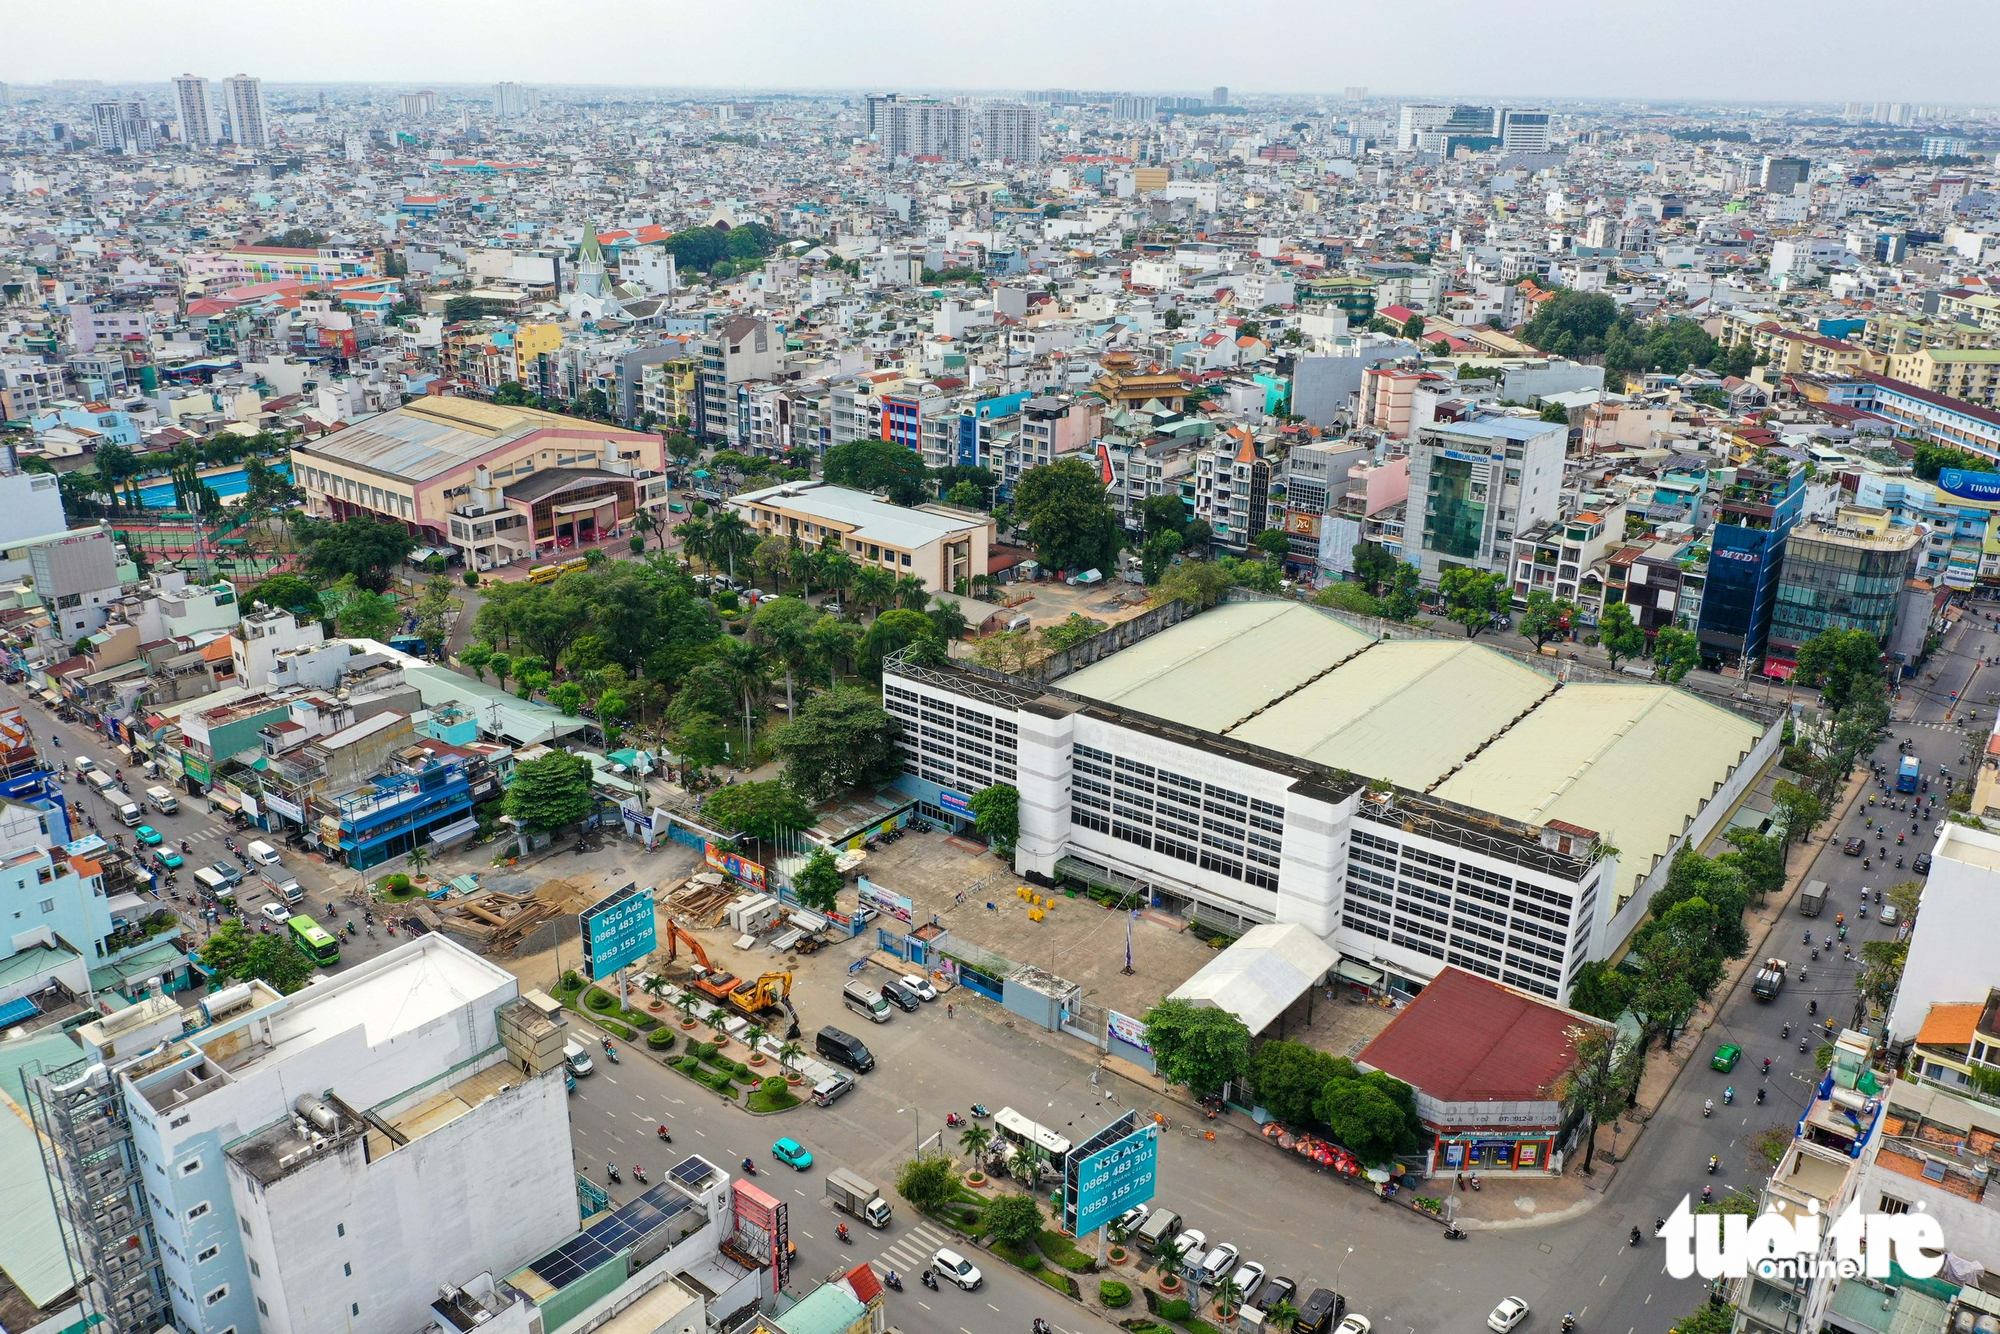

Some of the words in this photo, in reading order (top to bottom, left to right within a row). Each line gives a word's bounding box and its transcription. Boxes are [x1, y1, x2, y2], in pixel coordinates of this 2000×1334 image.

[1458, 454, 1488, 463] BUILDING
[1818, 528, 1856, 538] LOTTERIA
[1720, 550, 1753, 562] MTD
[595, 927, 616, 944] 0868
[618, 917, 634, 931] 483
[636, 908, 651, 921] 301
[602, 910, 622, 927] NSG
[625, 901, 642, 915] Ads
[597, 947, 617, 963] 0859
[620, 937, 635, 950] 155
[638, 927, 653, 941] 759
[1083, 1172, 1109, 1192] 0868
[1112, 1160, 1131, 1177] 483
[1135, 1148, 1153, 1165] 301
[1094, 1152, 1119, 1172] NSG
[1082, 1196, 1107, 1216] 0859
[1112, 1184, 1130, 1200] 155
[1134, 1172, 1152, 1188] 759
